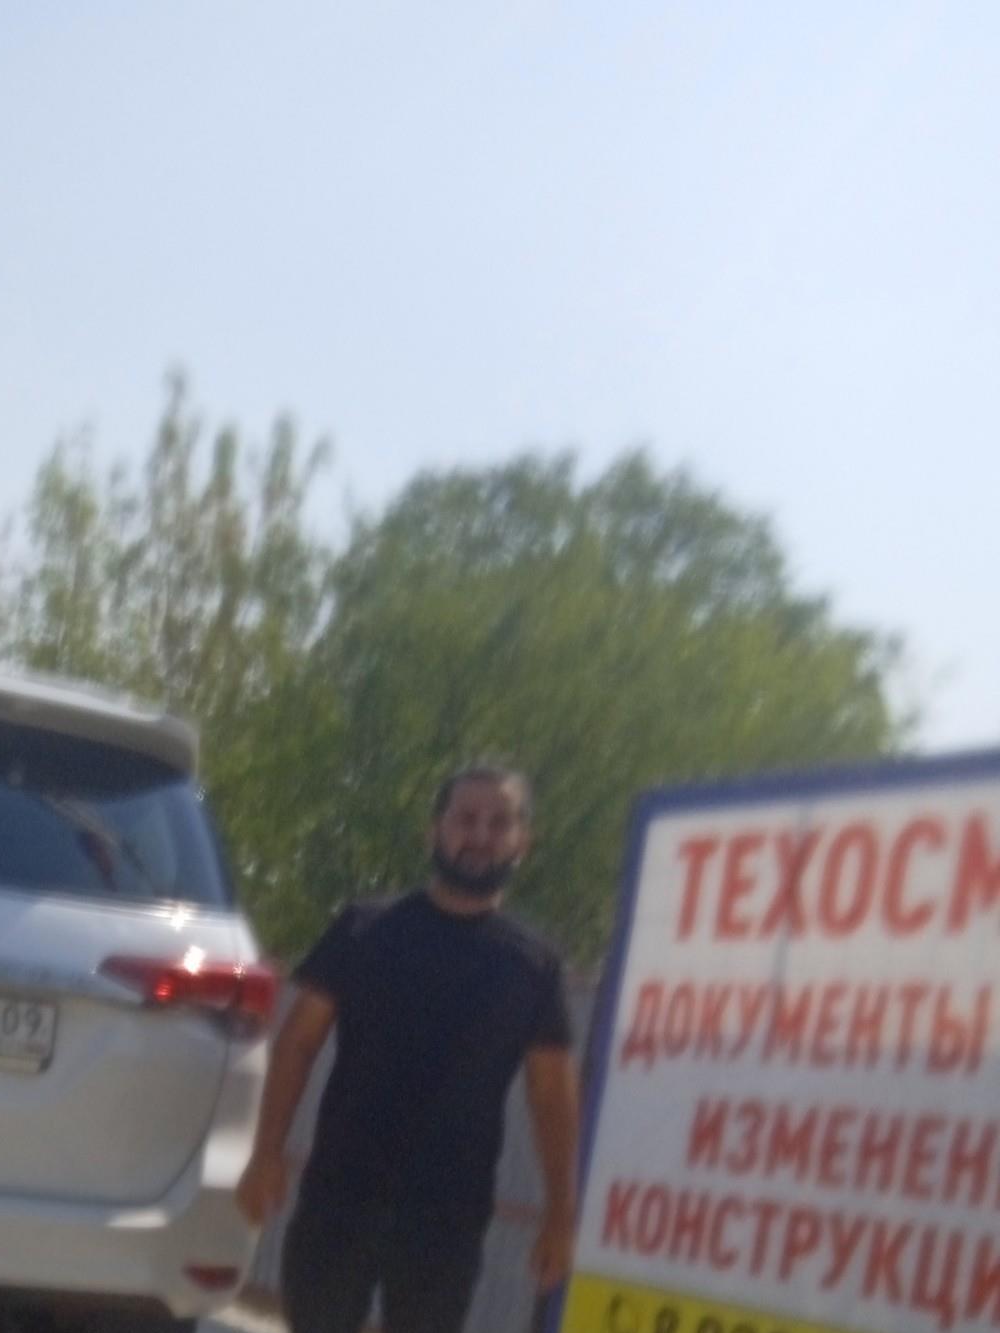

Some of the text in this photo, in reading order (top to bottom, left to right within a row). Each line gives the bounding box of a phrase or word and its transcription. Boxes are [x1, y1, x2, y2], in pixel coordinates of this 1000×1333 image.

[2, 1003, 43, 1039] 09
[619, 978, 992, 1076] ДОКУМЕНТЫ
[685, 1096, 1000, 1212] ИЗМЕНЕН
